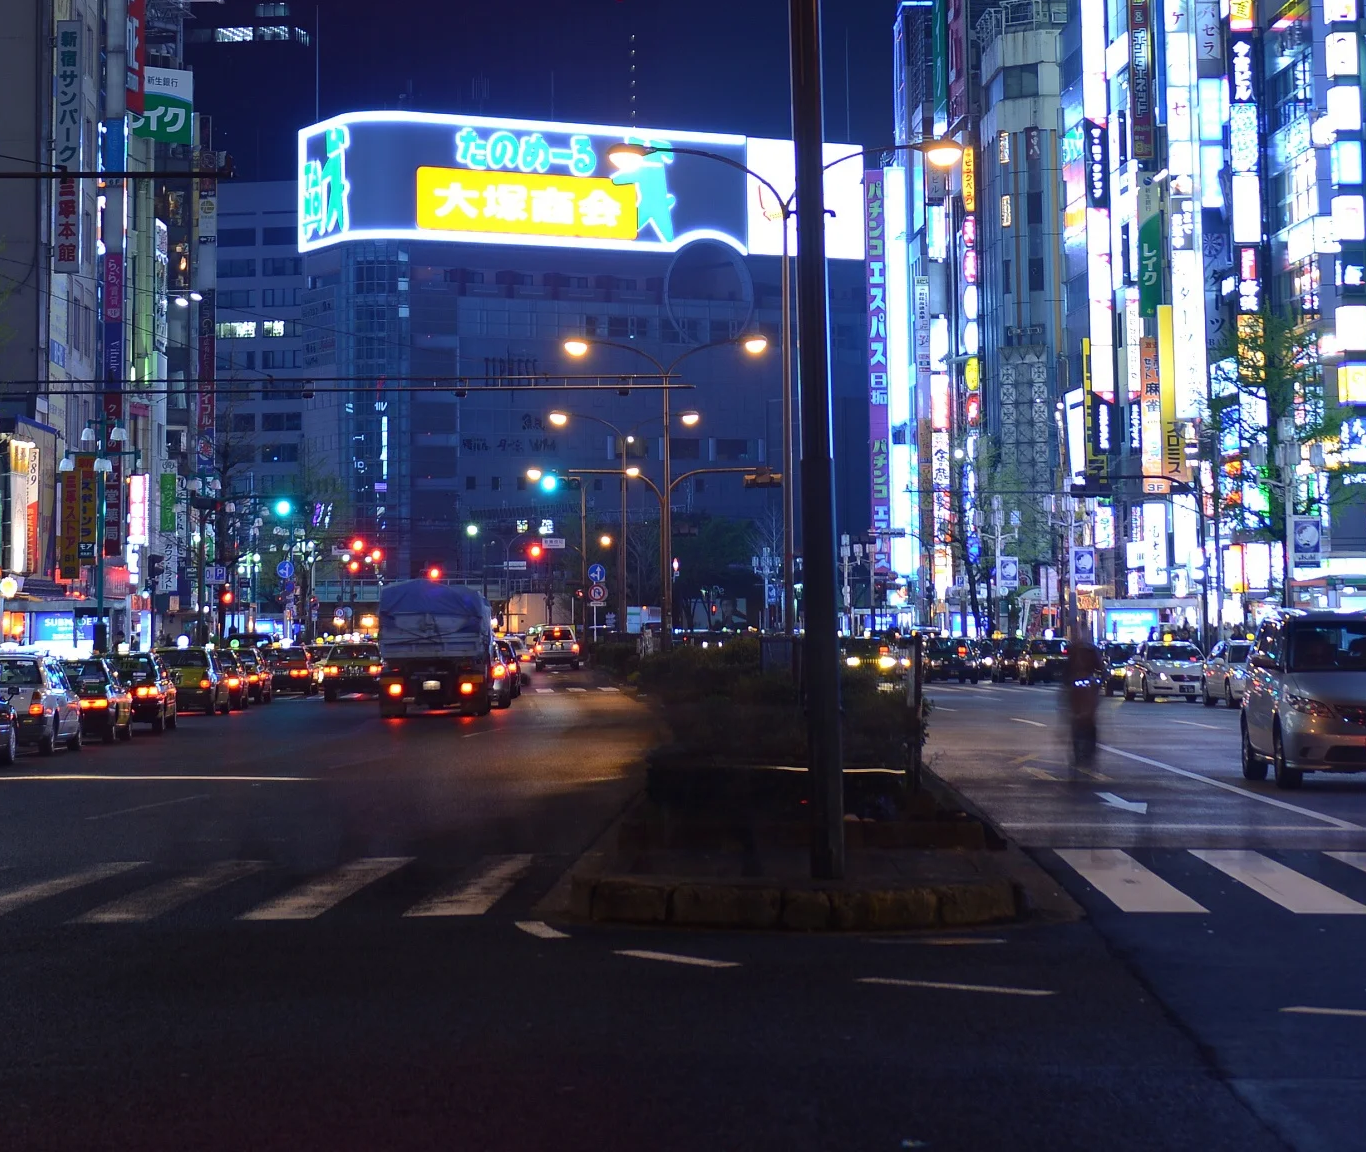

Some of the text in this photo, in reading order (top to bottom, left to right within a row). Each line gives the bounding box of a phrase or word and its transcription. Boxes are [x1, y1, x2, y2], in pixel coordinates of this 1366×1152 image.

[1201, 6, 1217, 56] パセラ
[58, 30, 80, 164] 新宿サンパーク
[146, 76, 179, 87] 新生銀行
[456, 128, 598, 177] たのめーる
[433, 182, 623, 229] 大塚商会
[868, 180, 884, 257] パチンコ
[1142, 243, 1158, 286] レイク
[869, 260, 887, 366] エスパス
[870, 371, 888, 406] 日拓
[1143, 356, 1153, 380] セット
[1144, 382, 1161, 413] 麻雀
[29, 451, 40, 485] 389
[872, 437, 888, 500] パチンコ
[1146, 482, 1165, 493] 3F
[218, 568, 225, 578] P
